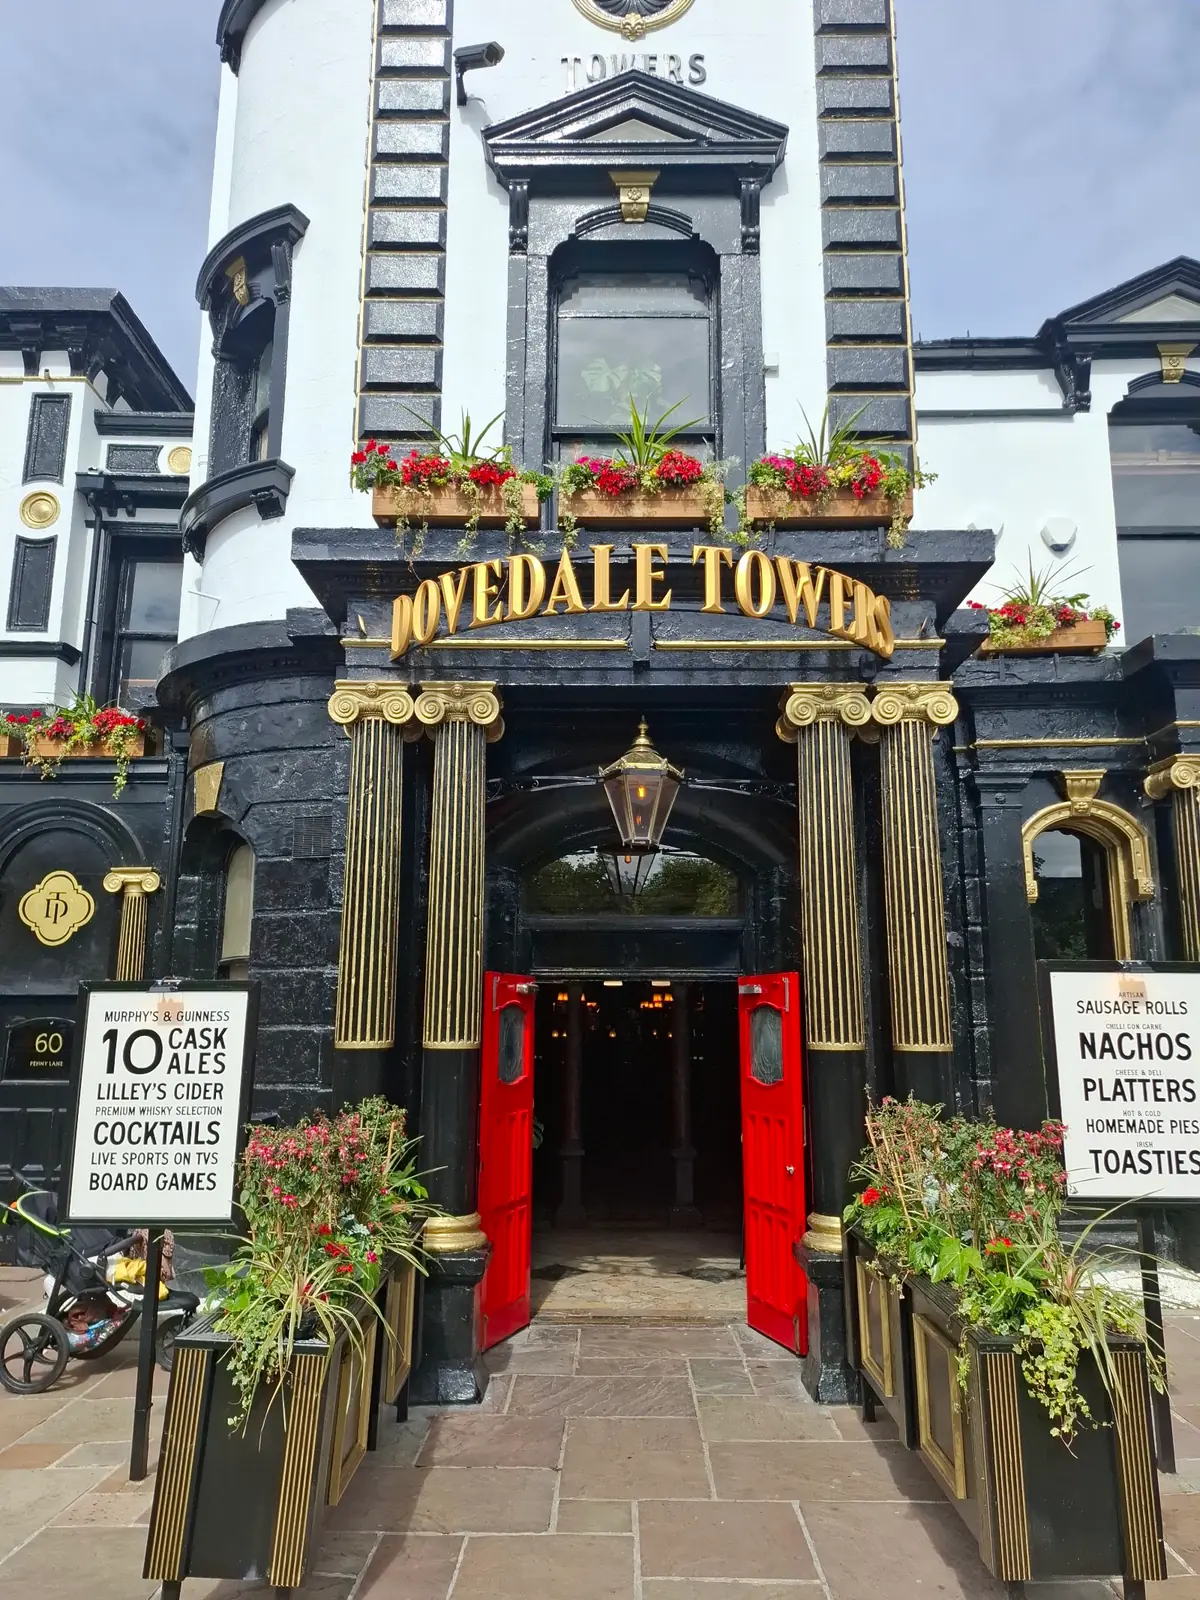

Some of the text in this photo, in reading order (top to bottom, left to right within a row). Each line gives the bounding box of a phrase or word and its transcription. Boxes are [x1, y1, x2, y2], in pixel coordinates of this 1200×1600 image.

[560, 53, 707, 94] TOWERS
[390, 543, 896, 662] DOVEDALE TOWERS
[105, 1011, 229, 1022] MURPHY'S & GUINNESS
[1077, 1000, 1187, 1015] SAUSAGE ROLLS
[1142, 1023, 1163, 1031] CARNE
[35, 1032, 63, 1053] 60
[103, 1028, 227, 1074] 10 CASK
[1079, 1032, 1191, 1060] NACHOS
[167, 1053, 225, 1074] ALES
[1148, 1069, 1162, 1077] DELI
[97, 1083, 223, 1100] LILLEY'S CIDER
[1083, 1078, 1196, 1102] PLATTERS
[96, 1106, 222, 1115] PREMIUM WHISKY SELECTION
[94, 1121, 220, 1145] COCKTAILS
[1086, 1119, 1199, 1134] HOMEMADE PIES
[91, 1152, 218, 1165] LIVE SPORTS ON TVS
[1088, 1149, 1200, 1175] TOASTIES
[90, 1173, 216, 1190] BOARD GAMES
